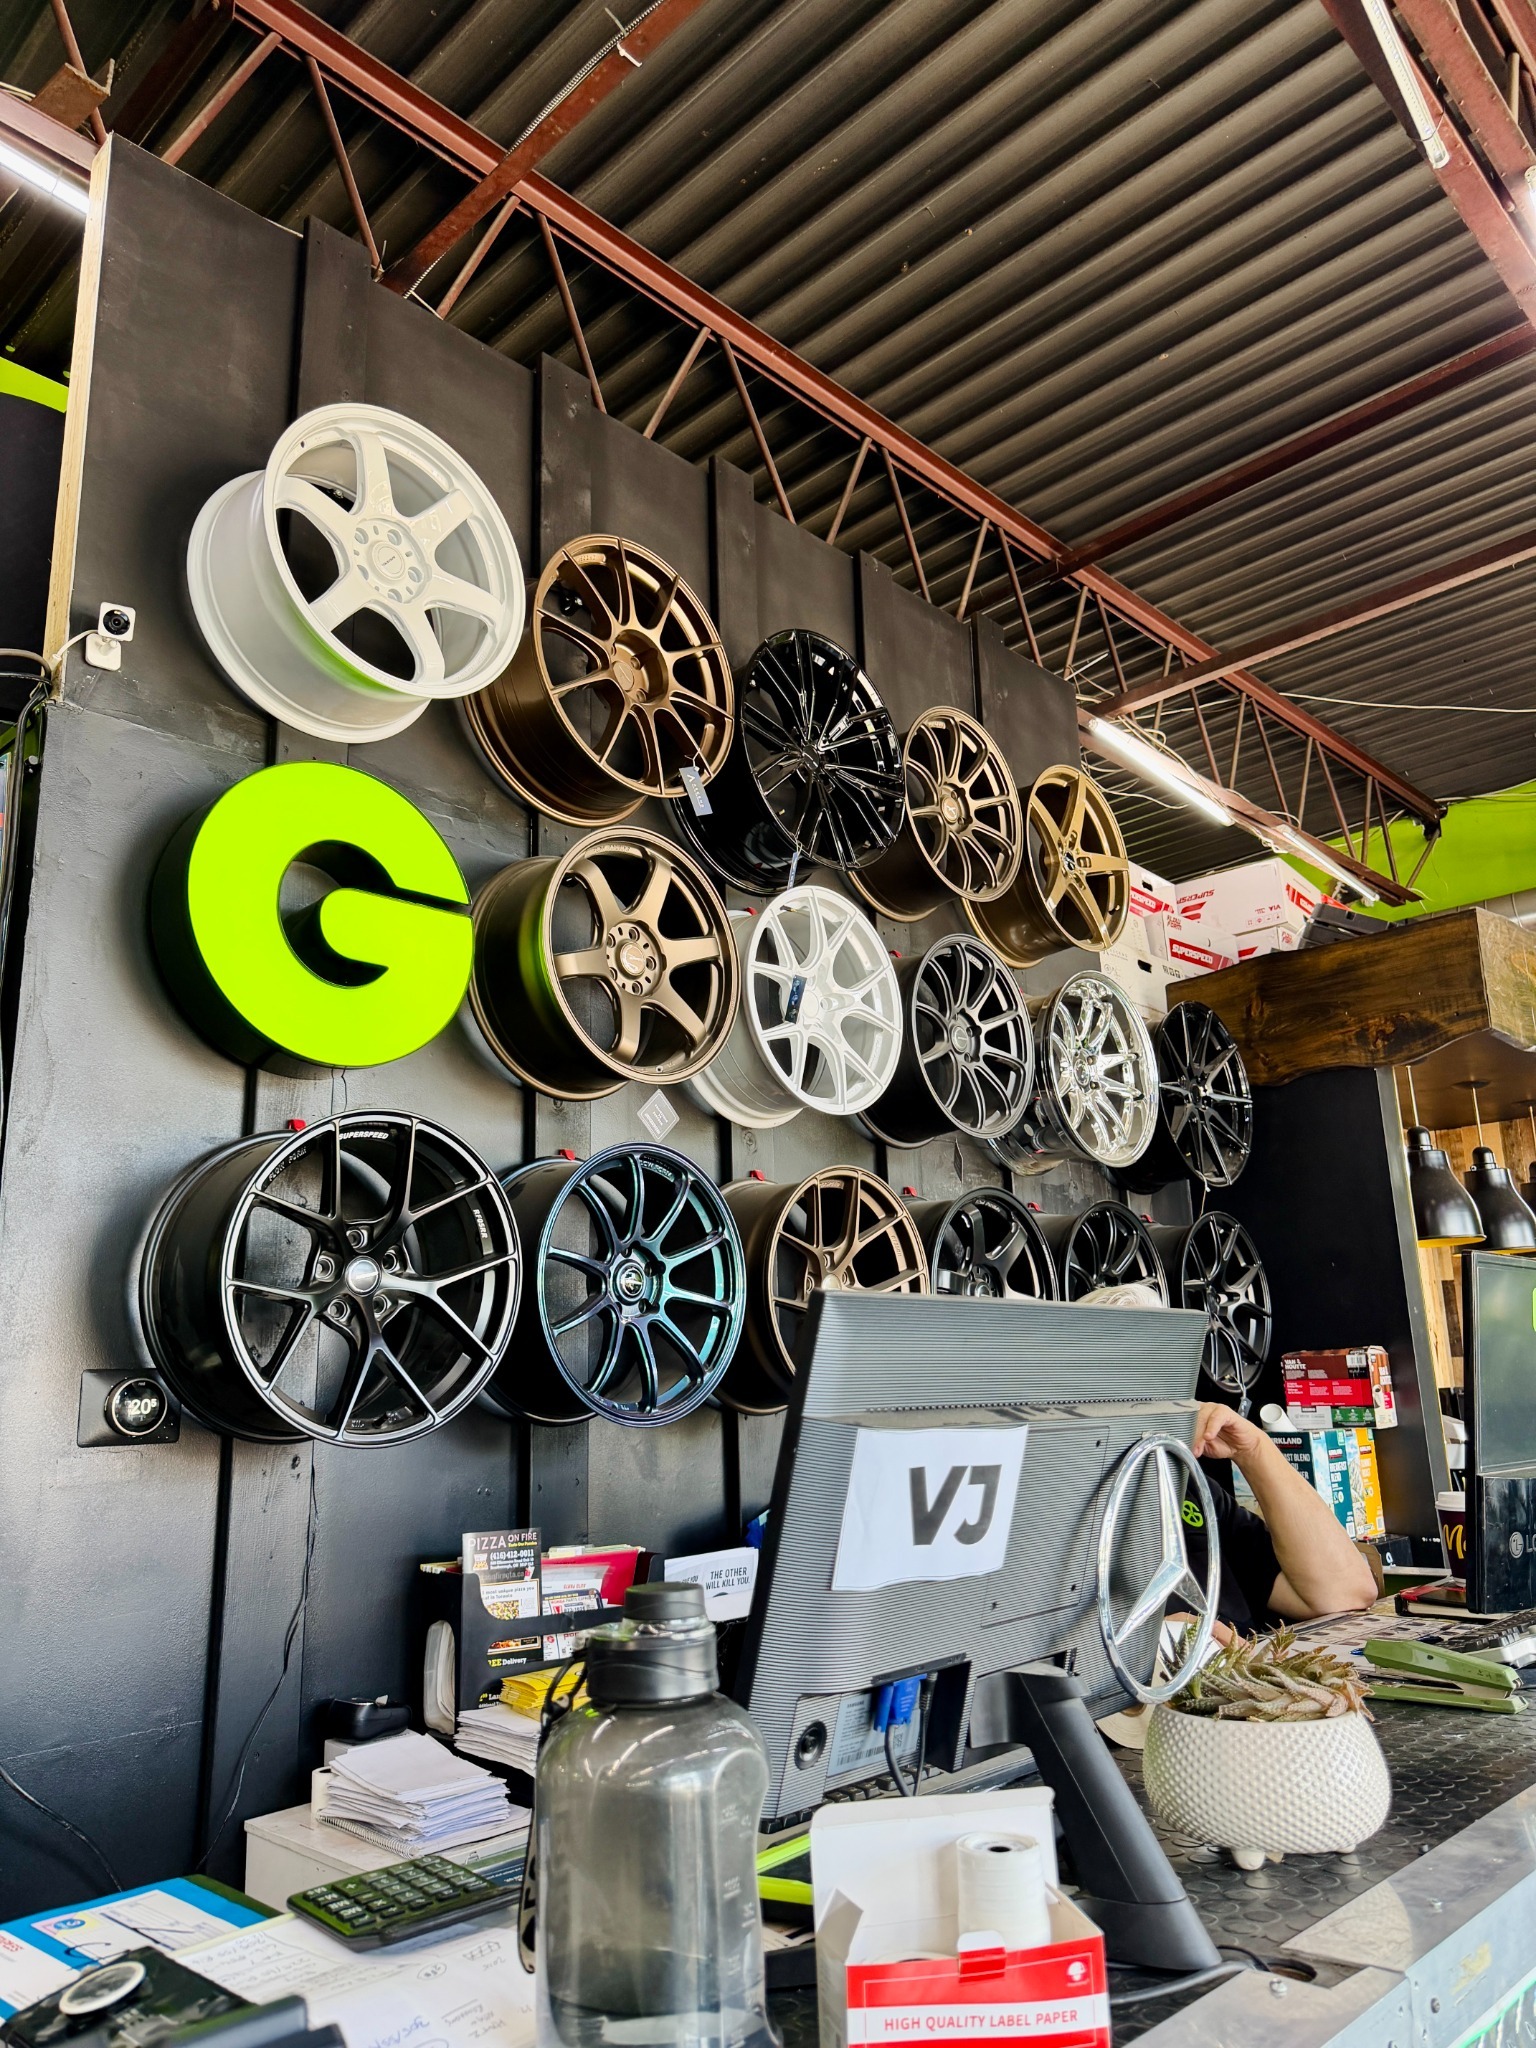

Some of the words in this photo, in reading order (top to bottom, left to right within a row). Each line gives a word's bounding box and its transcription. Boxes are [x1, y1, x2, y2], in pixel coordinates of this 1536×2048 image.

[1172, 943, 1213, 964] SUPERSPEED
[338, 1130, 389, 1141] SUPERSPEED
[909, 1464, 1002, 1546] VJ
[468, 1535, 507, 1550] PIZZA
[508, 1533, 520, 1542] ON
[521, 1532, 537, 1541] FIRE
[710, 1569, 724, 1580] THE
[725, 1567, 748, 1578] OTHER
[705, 1580, 720, 1590] WILL
[721, 1578, 735, 1588] KILL
[502, 1657, 527, 1666] Delivery
[884, 2016, 920, 2031] HIGH
[925, 2015, 985, 2031] QUALITY
[989, 2013, 1031, 2027] LABEL
[1035, 2009, 1078, 2025] PAPER
